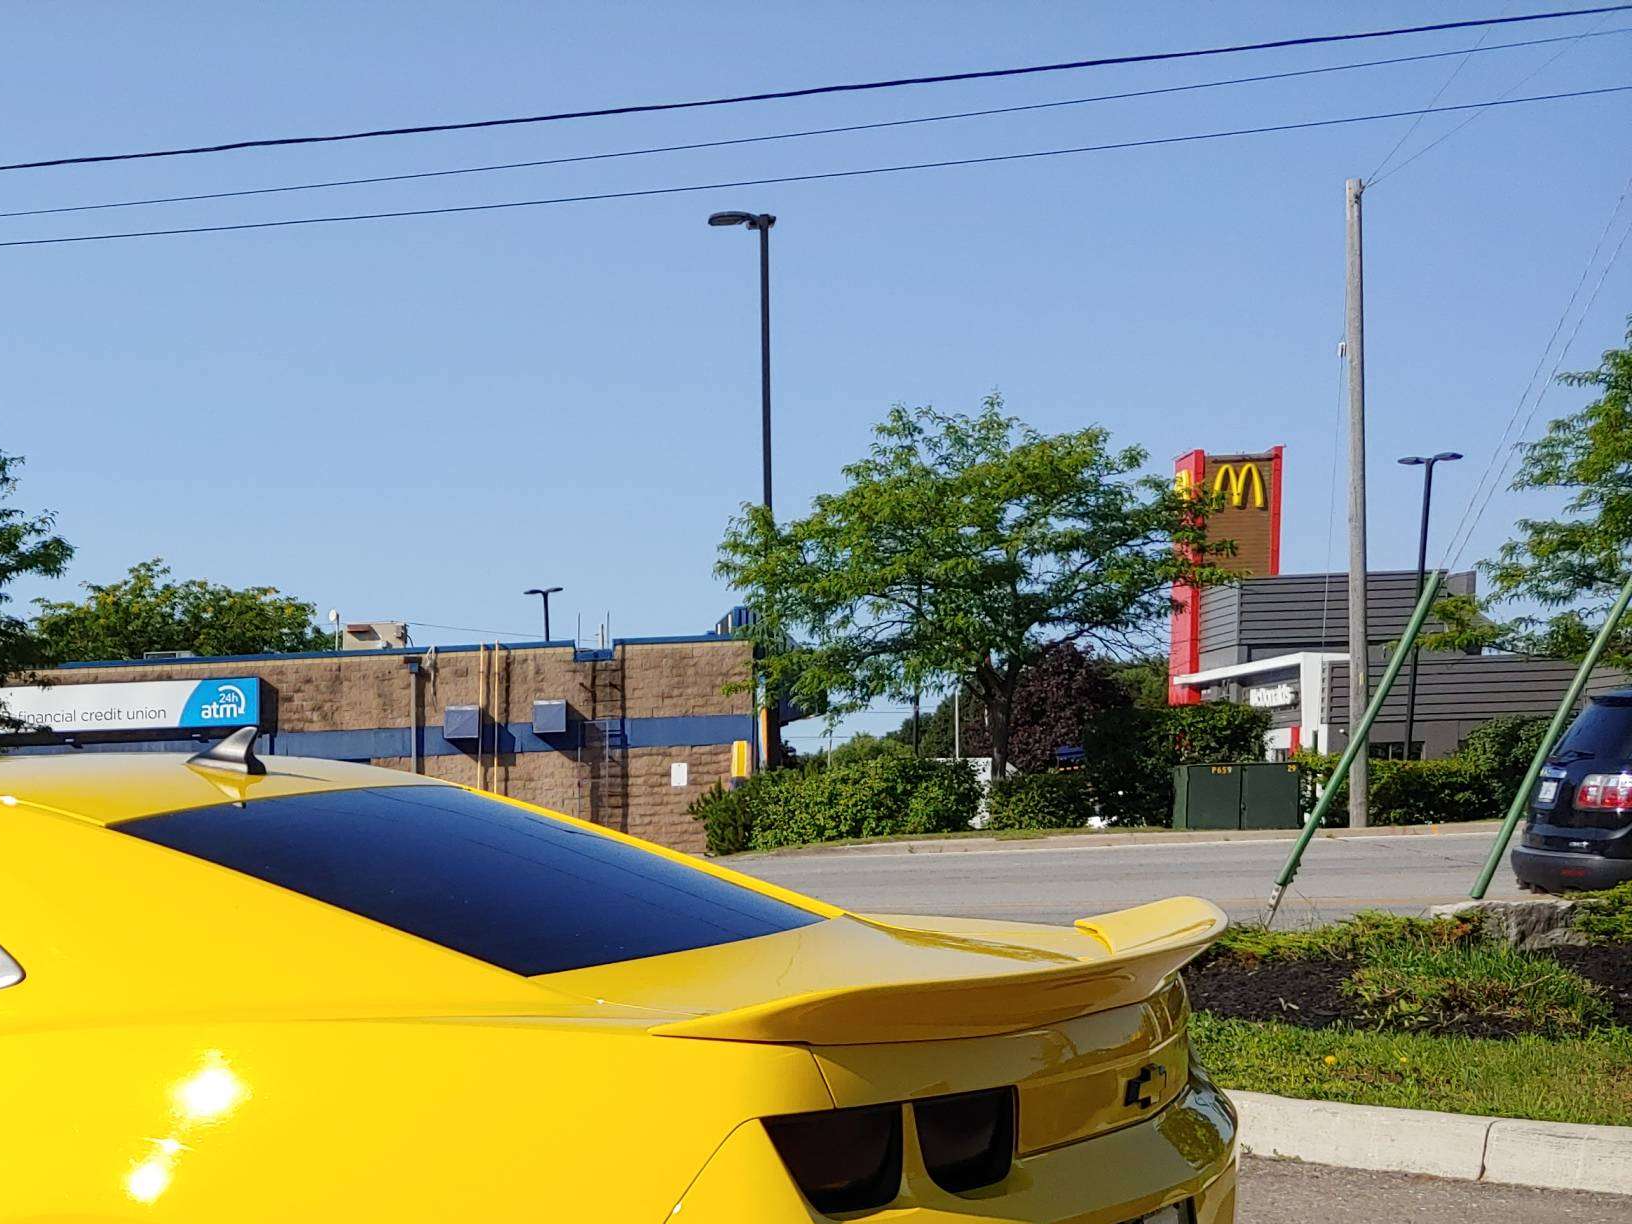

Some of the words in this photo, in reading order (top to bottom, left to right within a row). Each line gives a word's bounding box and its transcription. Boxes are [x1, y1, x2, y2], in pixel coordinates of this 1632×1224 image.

[218, 692, 238, 703] 24h
[18, 709, 76, 725] financial
[81, 708, 122, 722] credit
[126, 707, 167, 720] union
[201, 702, 238, 719] atm
